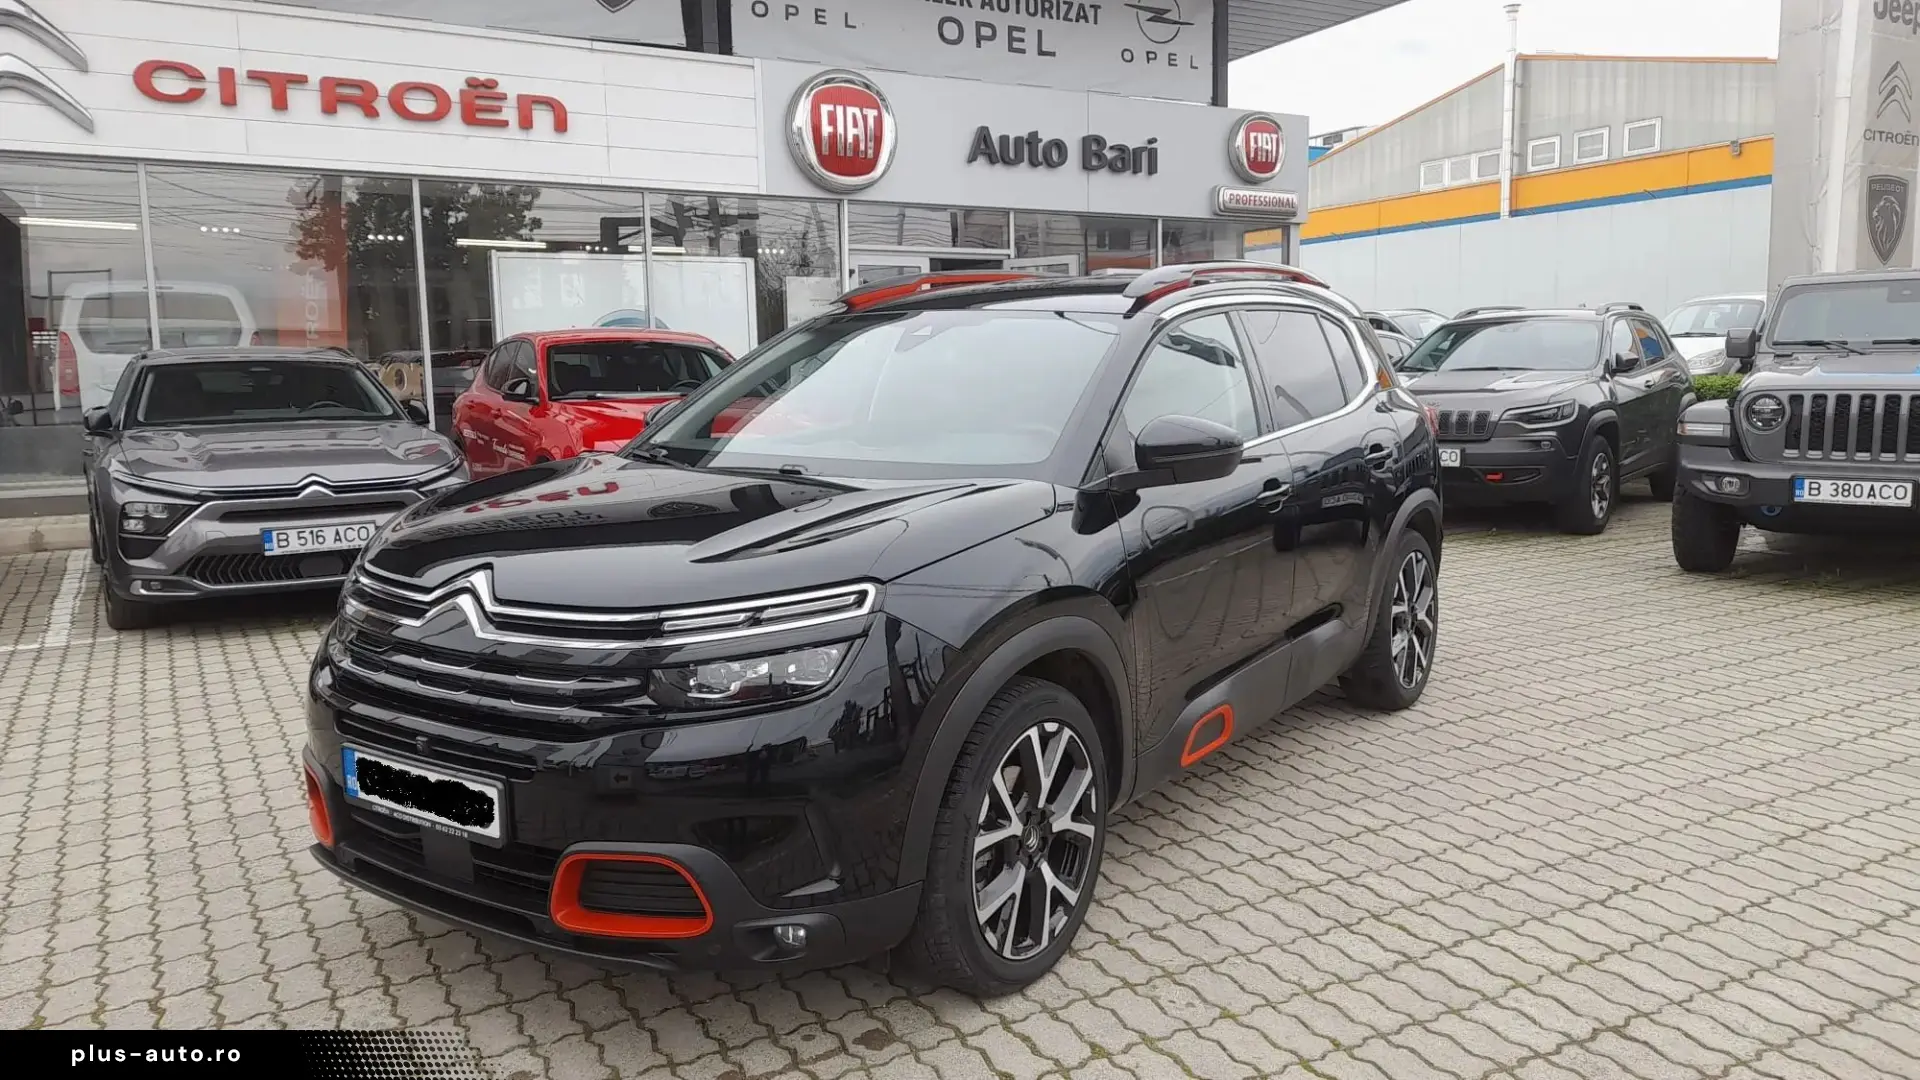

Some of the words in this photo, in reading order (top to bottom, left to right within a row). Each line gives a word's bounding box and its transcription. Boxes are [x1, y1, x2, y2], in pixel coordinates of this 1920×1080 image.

[751, 0, 857, 29] OPEL
[937, 16, 1056, 57] OPEL
[1121, 48, 1199, 69] OPEL
[820, 103, 878, 159] FIAT
[967, 125, 1069, 168] Auto
[1081, 134, 1158, 176] Bari
[1249, 131, 1278, 163] FIAT
[1228, 192, 1296, 209] PROFESSIONAL
[1808, 481, 1821, 497] B
[1829, 482, 1864, 499] 380
[1867, 483, 1908, 500] ACO
[276, 532, 290, 549] B
[297, 529, 326, 546] 516
[333, 525, 370, 544] ACO
